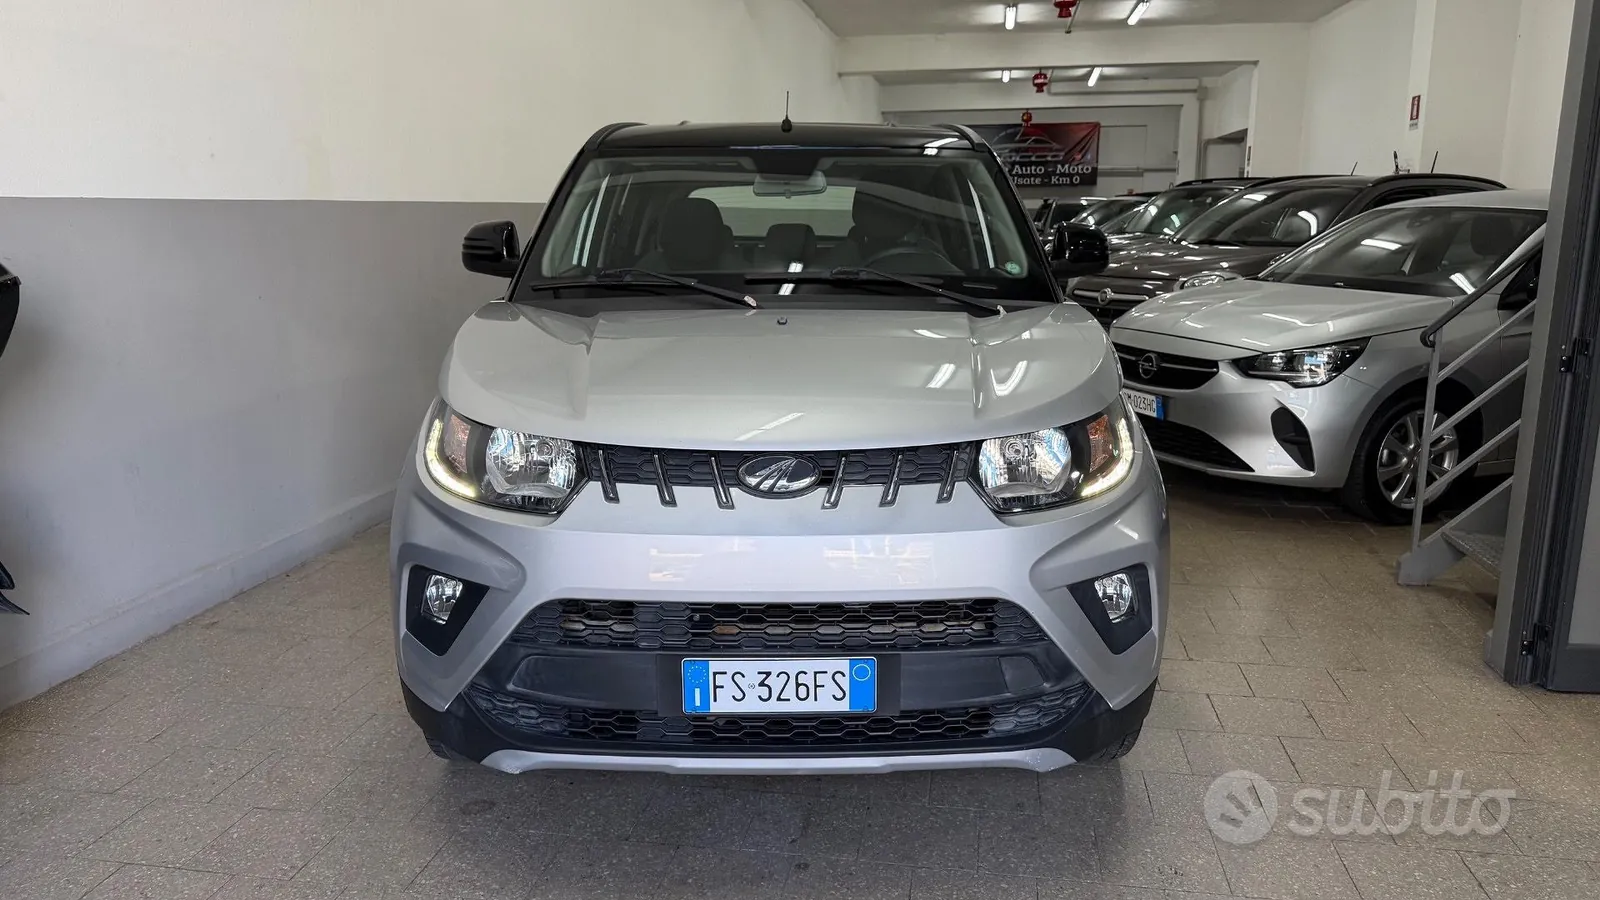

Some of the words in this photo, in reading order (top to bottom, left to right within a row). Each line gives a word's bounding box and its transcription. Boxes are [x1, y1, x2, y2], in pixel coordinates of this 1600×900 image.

[1011, 164, 1045, 175] Auto
[1056, 164, 1092, 174] Moto
[1051, 175, 1070, 185] Km
[1072, 175, 1080, 184] 0
